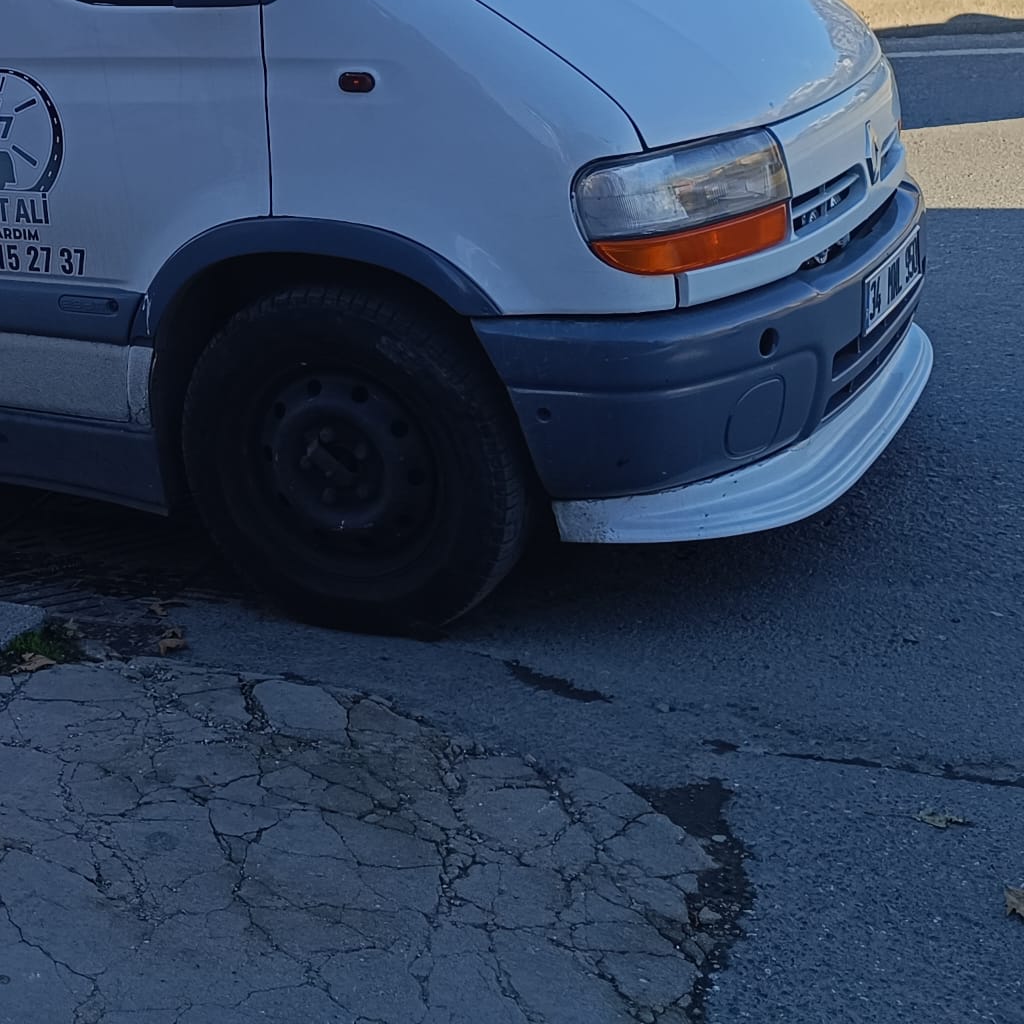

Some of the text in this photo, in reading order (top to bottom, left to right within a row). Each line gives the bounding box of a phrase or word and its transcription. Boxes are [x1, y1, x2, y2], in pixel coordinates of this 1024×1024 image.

[15, 193, 50, 224] ALİ
[26, 246, 52, 273] 27
[59, 248, 85, 276] 37
[869, 276, 881, 320] 34
